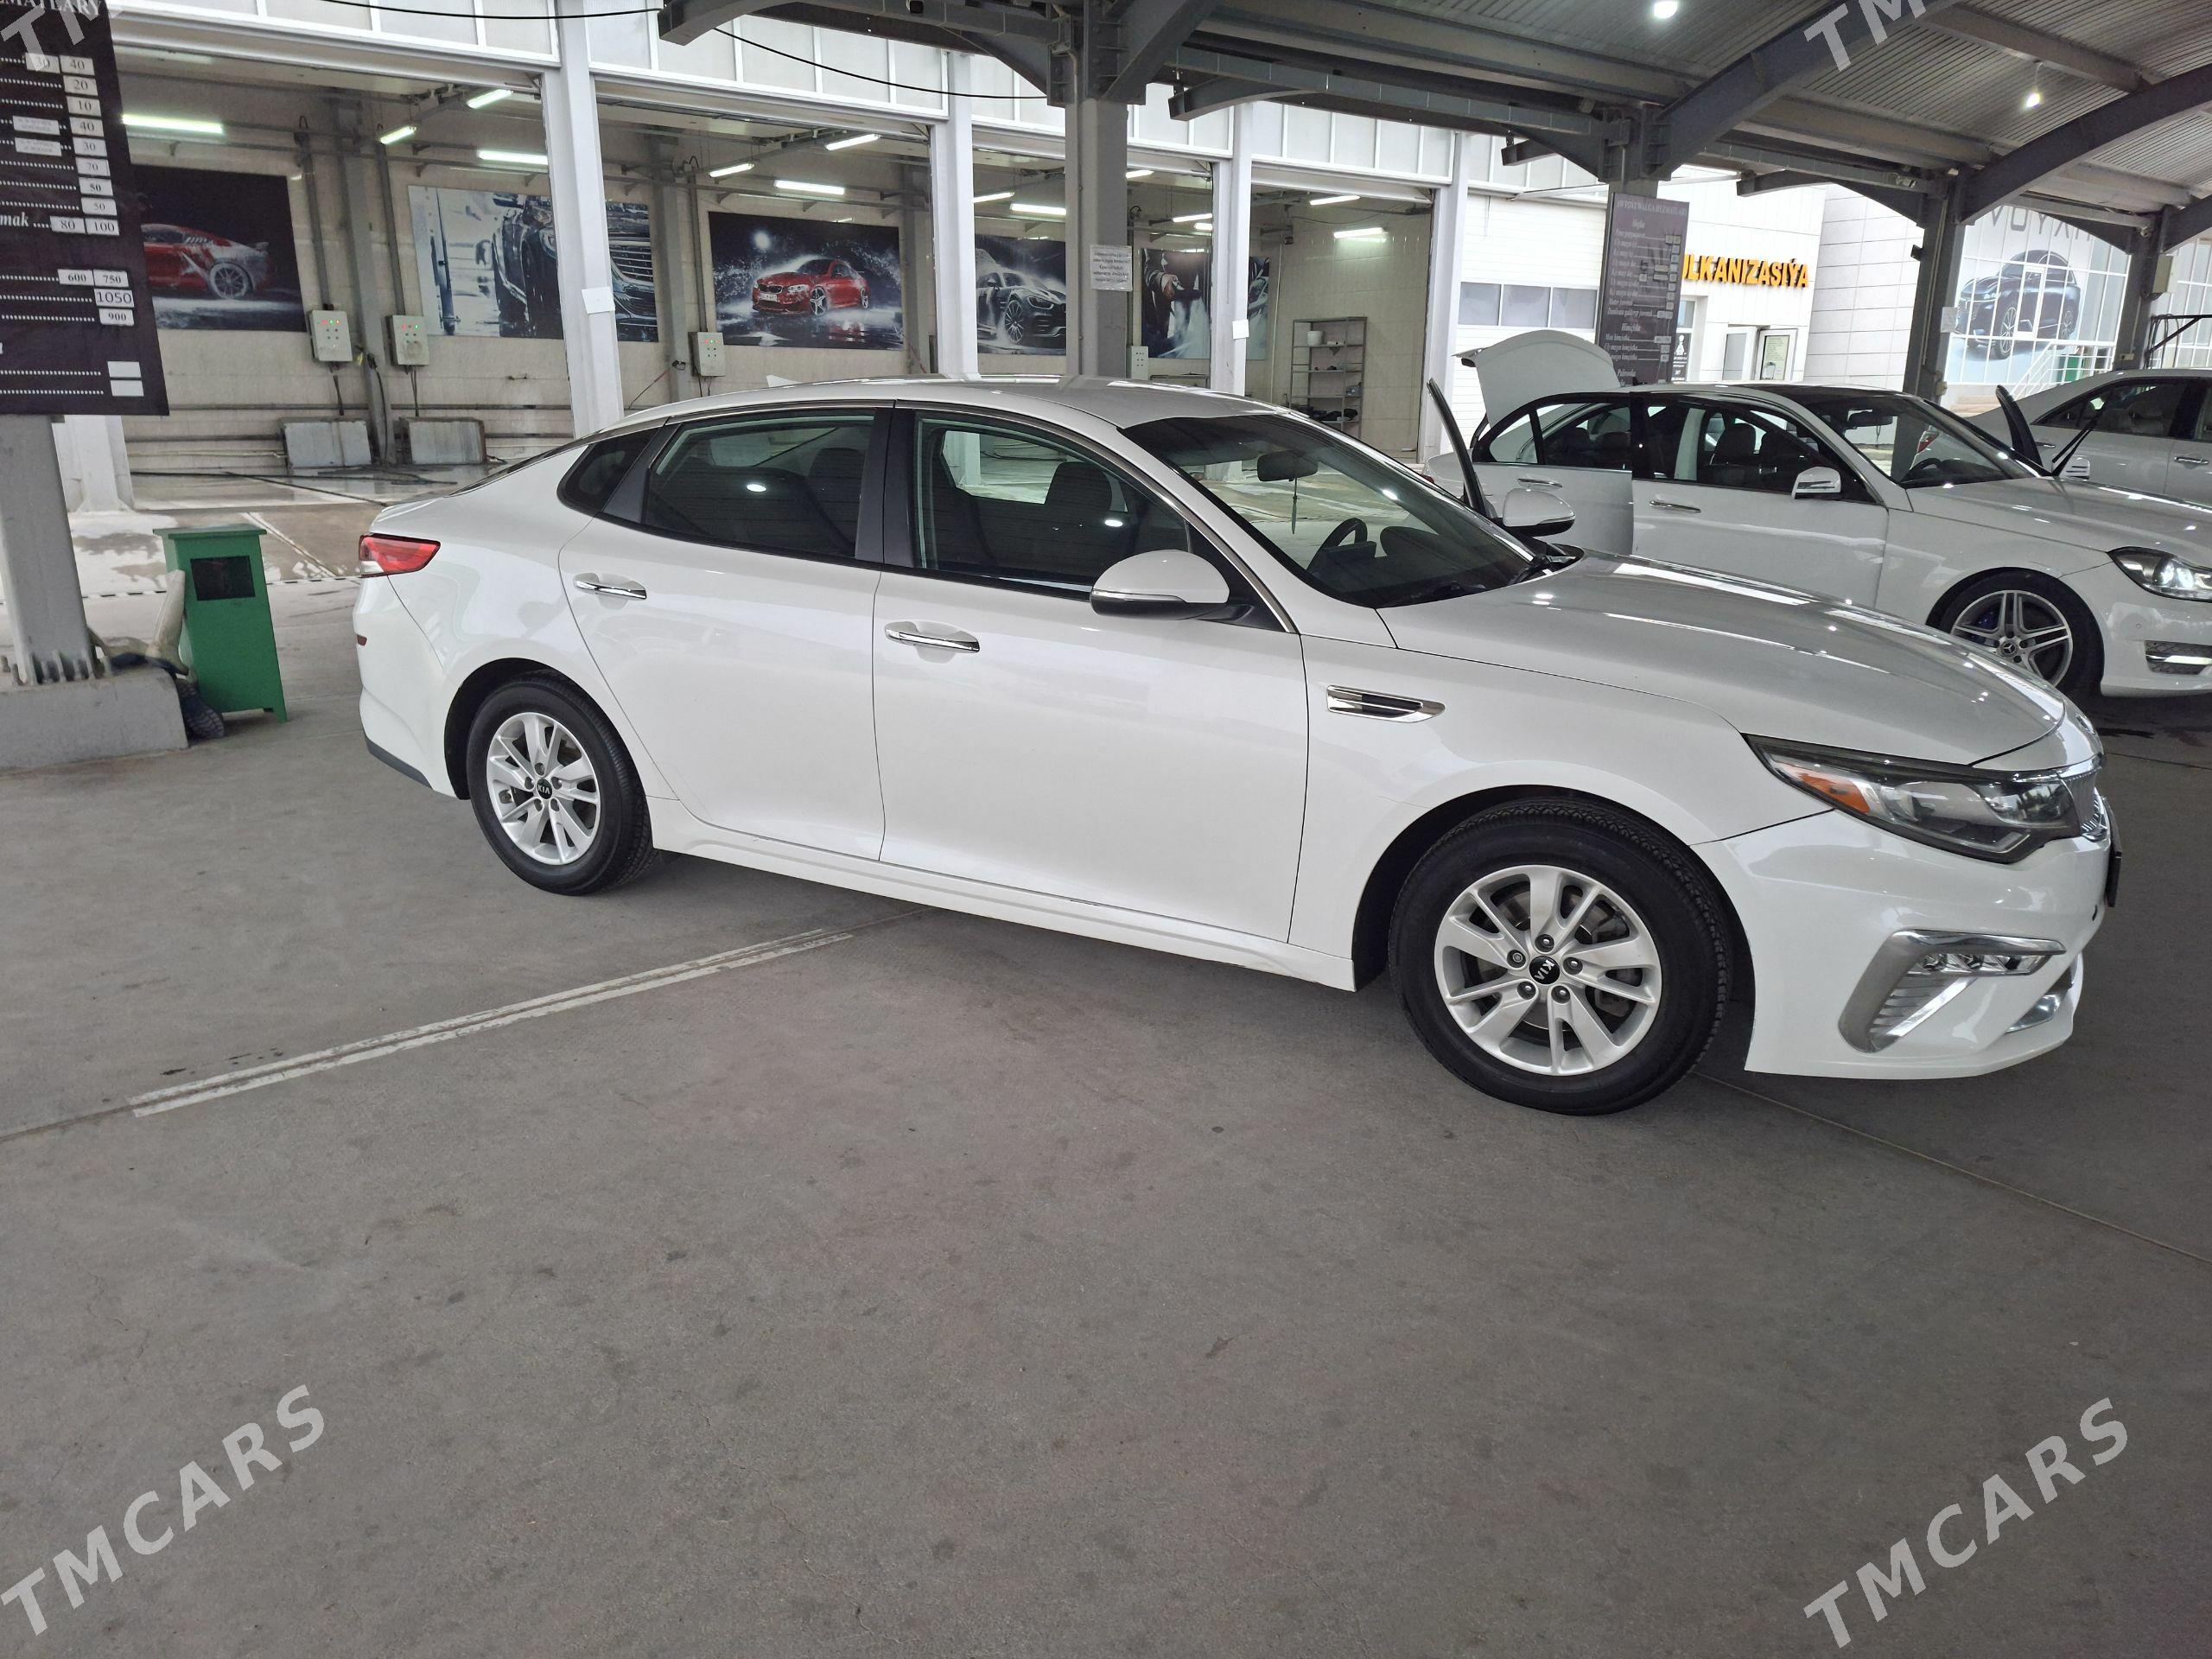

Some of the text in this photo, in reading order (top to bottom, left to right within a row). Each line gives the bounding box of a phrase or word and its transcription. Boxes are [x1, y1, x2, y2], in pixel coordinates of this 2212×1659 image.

[70, 60, 85, 71] 40
[74, 80, 88, 92] 20
[78, 100, 92, 111] 10
[80, 122, 95, 133] 40
[60, 220, 76, 231] 80
[93, 221, 115, 232] 100
[67, 274, 122, 283] 600 750
[97, 291, 132, 303] 1050
[108, 313, 127, 321] 900
[537, 785, 550, 794] KIA
[1534, 959, 1555, 980] KIA
